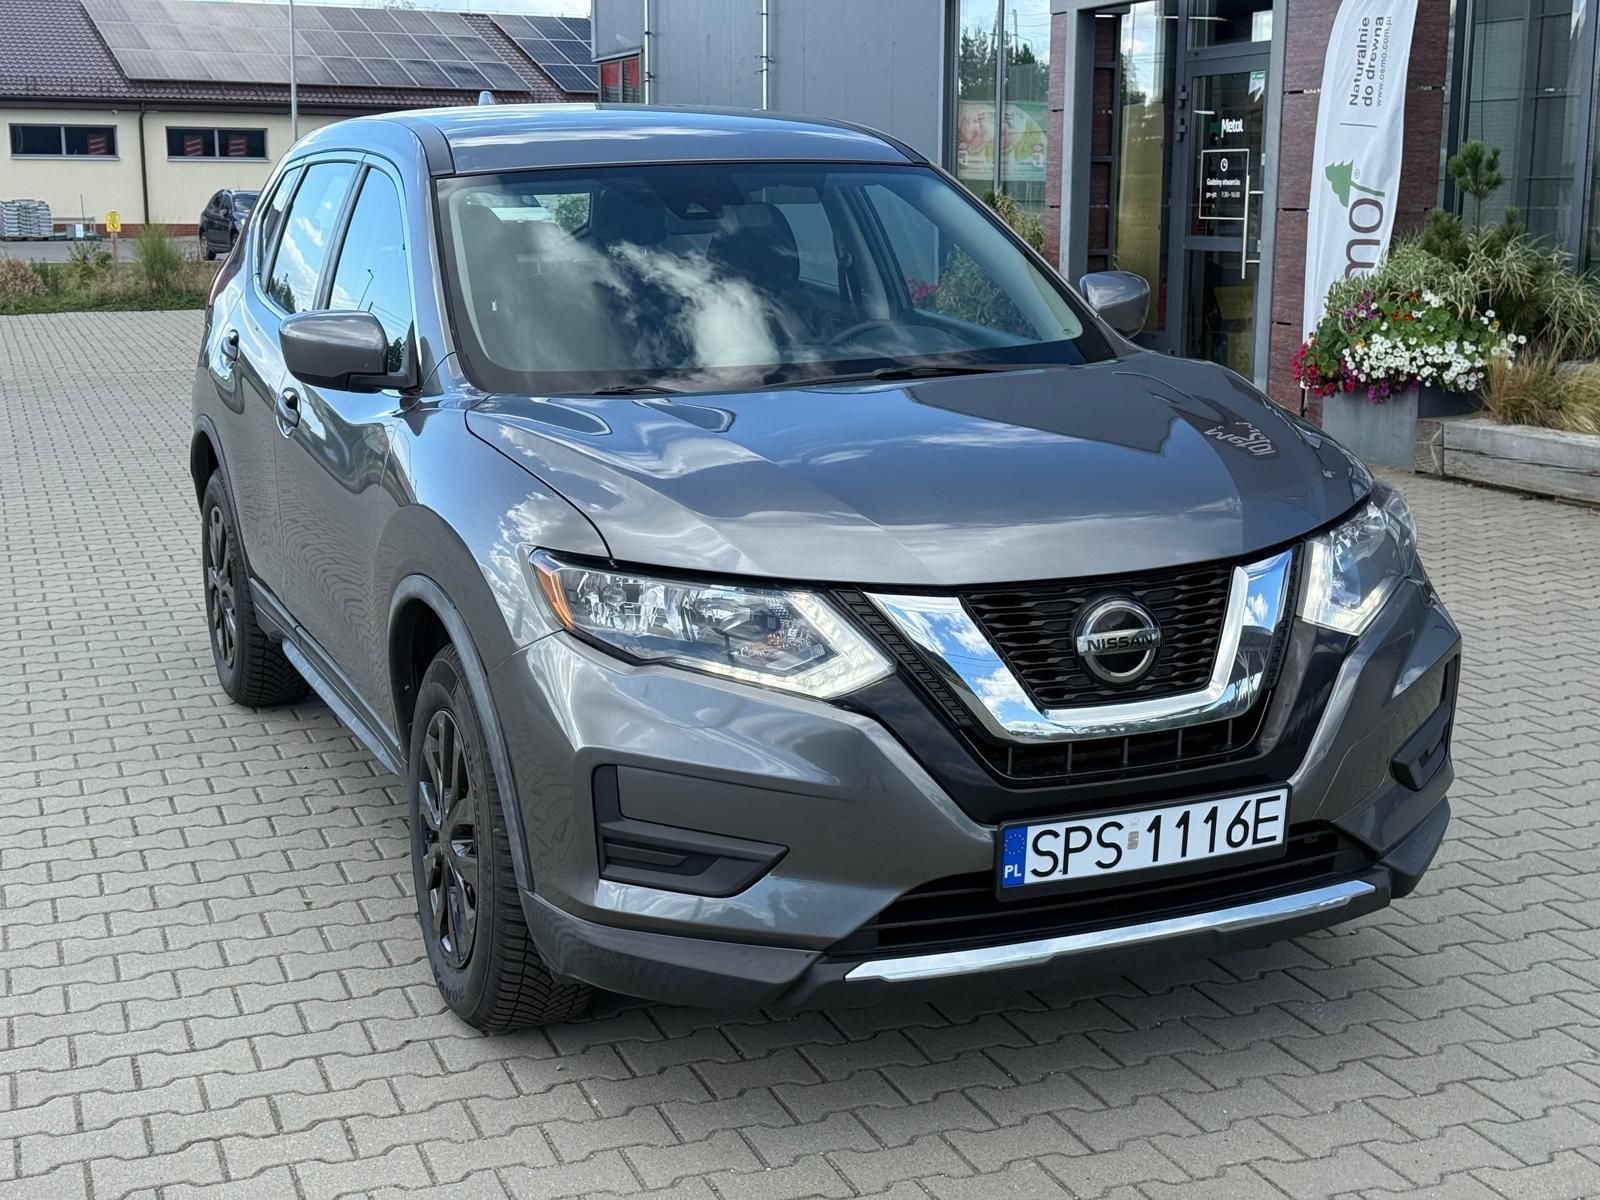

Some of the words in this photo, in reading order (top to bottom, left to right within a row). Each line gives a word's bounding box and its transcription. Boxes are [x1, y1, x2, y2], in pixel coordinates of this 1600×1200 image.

[1349, 17, 1370, 106] Naturalnie
[1365, 16, 1384, 80] drewna
[1376, 16, 1392, 107] www.osmo.com.pl
[1362, 85, 1374, 107] do
[1087, 634, 1153, 651] NISSAN
[1030, 820, 1124, 878] SPS
[1146, 794, 1281, 862] 1116E
[1004, 864, 1022, 879] PL
